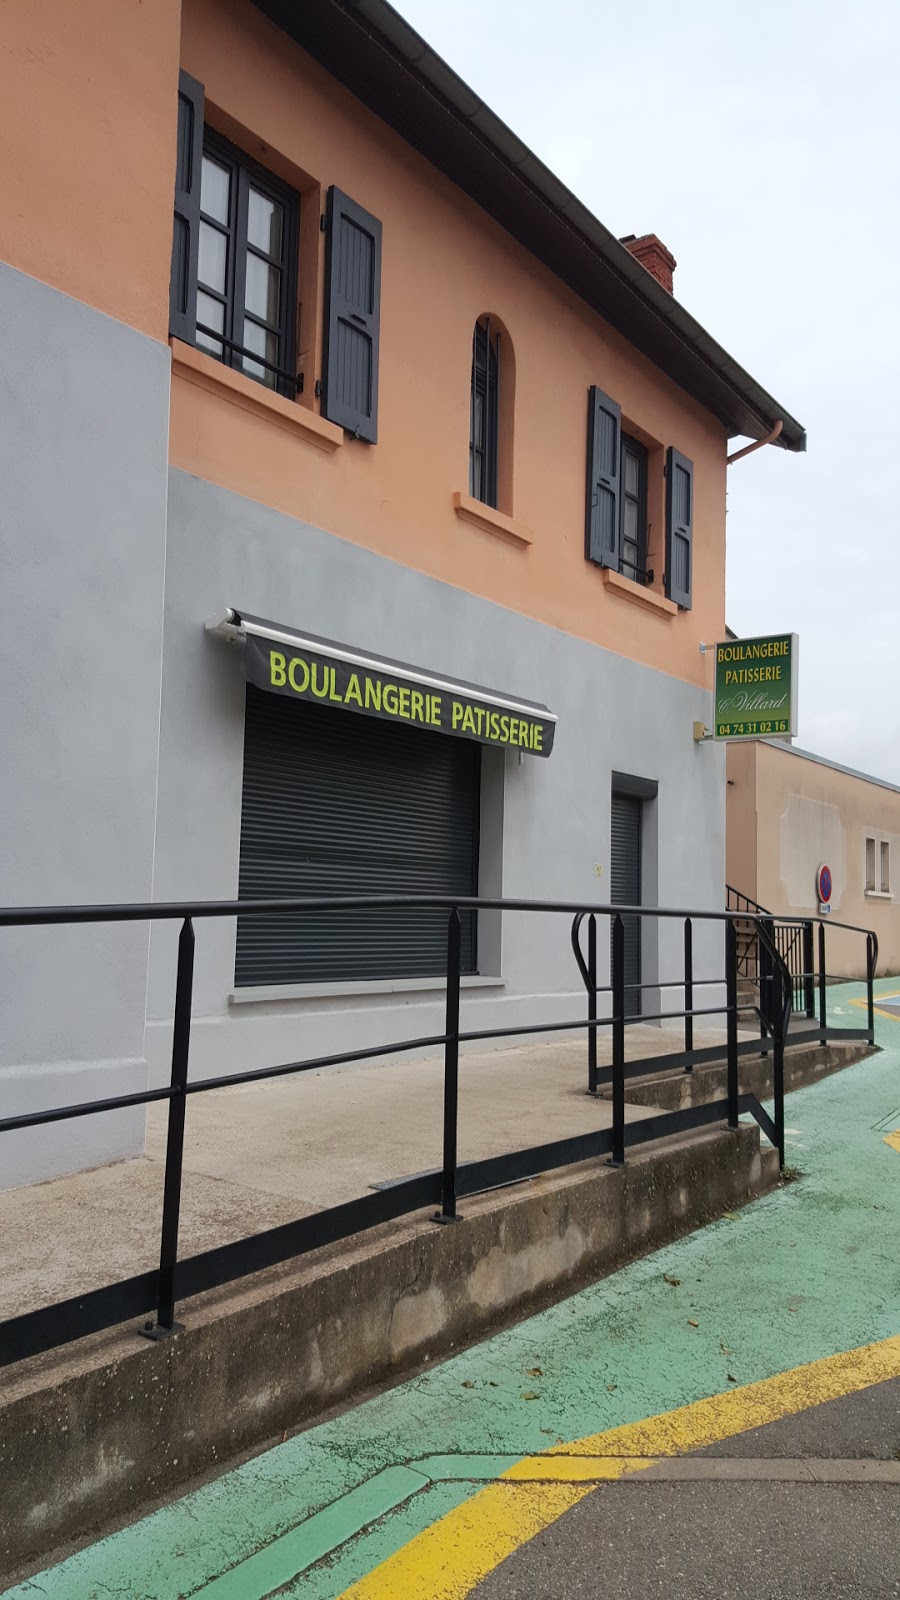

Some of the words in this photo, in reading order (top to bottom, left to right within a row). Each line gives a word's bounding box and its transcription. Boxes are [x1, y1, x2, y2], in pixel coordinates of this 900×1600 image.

[718, 640, 789, 662] BOULANGERIE
[725, 666, 781, 684] PATISSERIE
[270, 650, 441, 726] BOULANGERIE
[452, 701, 543, 751] PATISSERIE
[732, 690, 788, 712] Villard
[719, 724, 731, 735] 04
[733, 723, 744, 734] 74
[746, 722, 757, 733] 31
[760, 721, 772, 732] 02
[775, 720, 786, 731] 16
